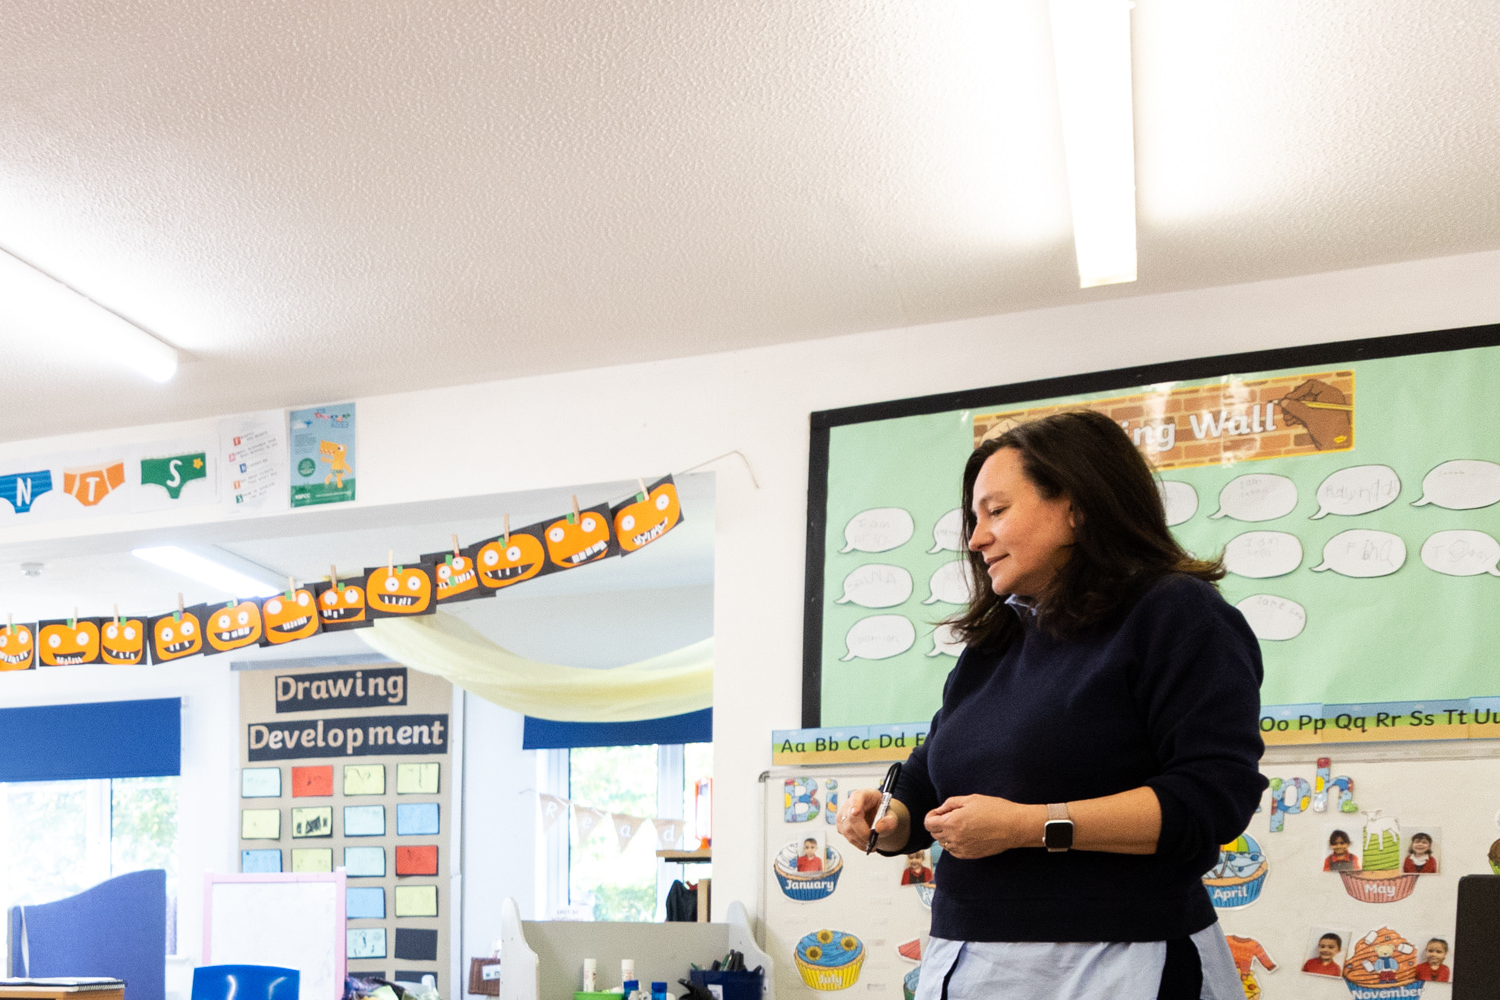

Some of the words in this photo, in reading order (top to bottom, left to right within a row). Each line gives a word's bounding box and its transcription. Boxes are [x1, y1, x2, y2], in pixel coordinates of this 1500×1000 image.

[1189, 402, 1277, 440] Wall
[276, 671, 404, 703] Drawing
[249, 719, 445, 754] Development
[781, 739, 807, 753] Aa
[815, 736, 839, 752] Bb
[848, 735, 870, 750] Cc
[879, 732, 905, 748] Dd
[915, 732, 927, 747] E
[1260, 716, 1289, 732] Oo
[1298, 714, 1326, 735] Pp
[1335, 713, 1367, 733] Qq
[1376, 711, 1402, 727] Rr
[1409, 710, 1435, 727] Ss
[1443, 709, 1468, 725] Tt
[785, 879, 835, 892] January
[1364, 883, 1396, 896] May
[1213, 886, 1248, 900] April
[817, 974, 843, 987] July
[1351, 986, 1425, 1000] November
